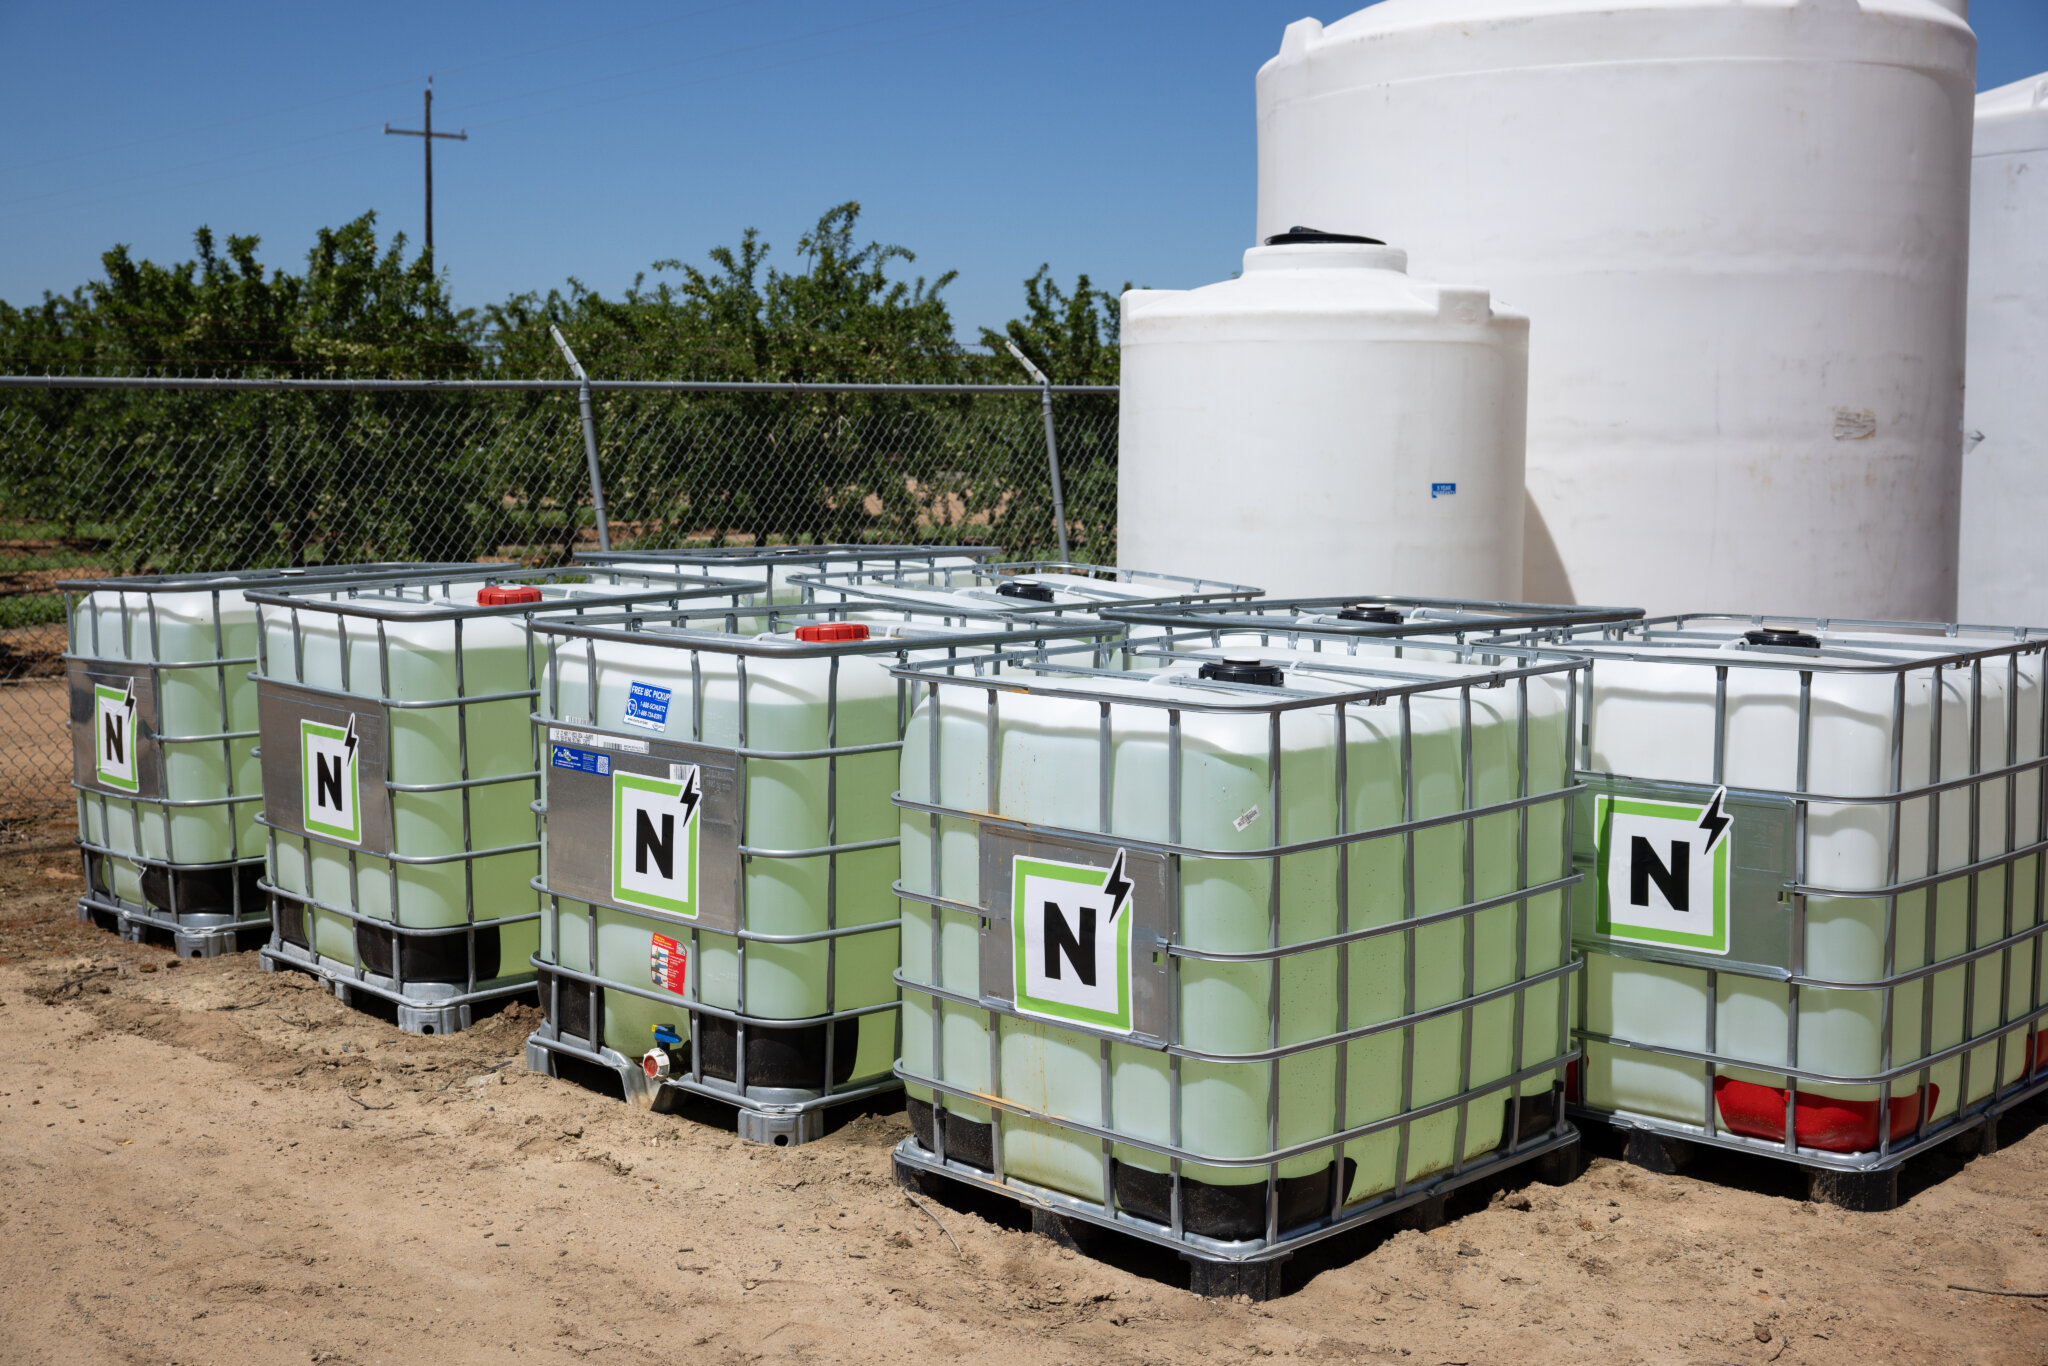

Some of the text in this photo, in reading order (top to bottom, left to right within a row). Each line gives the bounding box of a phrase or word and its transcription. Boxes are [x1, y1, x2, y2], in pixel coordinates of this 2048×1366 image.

[631, 685, 671, 702] FREE IBC PICKUP
[105, 712, 124, 764] N
[316, 752, 343, 812] N
[635, 808, 675, 880] N
[1630, 836, 1690, 913] N
[1043, 901, 1097, 987] N
